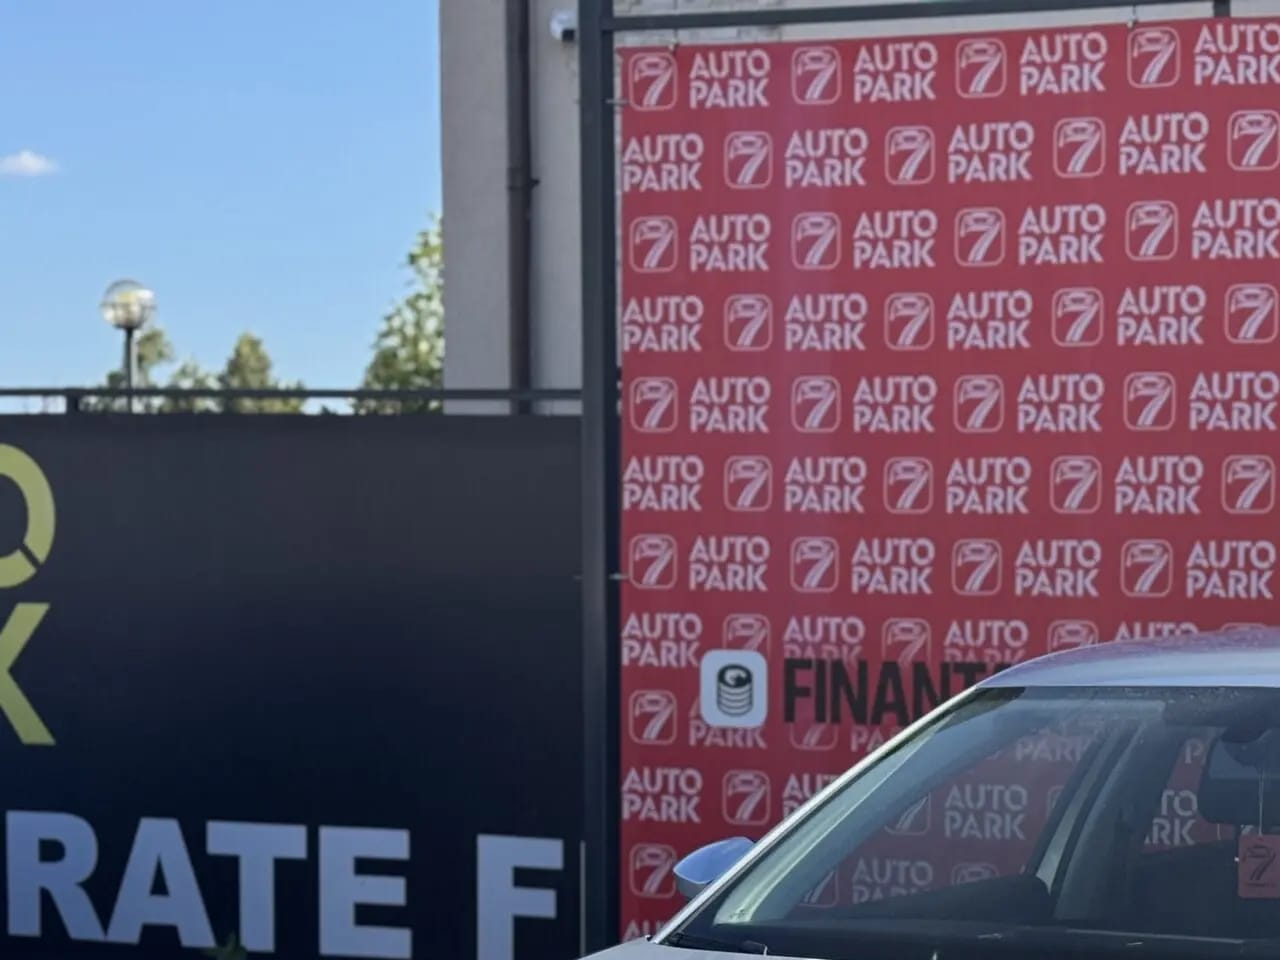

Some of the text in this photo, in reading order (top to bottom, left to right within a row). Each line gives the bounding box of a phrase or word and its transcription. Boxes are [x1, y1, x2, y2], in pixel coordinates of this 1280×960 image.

[855, 43, 937, 72] AUTO
[1021, 32, 1107, 64] AUTO
[690, 50, 770, 78] AUTO
[1020, 62, 1105, 95] PARK
[690, 78, 768, 108] PARK
[854, 71, 936, 102] PARK
[948, 121, 1034, 154] AUTO
[1119, 112, 1209, 145] AUTO
[623, 133, 704, 164] AUTO
[784, 128, 868, 159] AUTO
[785, 156, 866, 187] PARK
[948, 151, 1032, 183] PARK
[1120, 142, 1206, 175] PARK
[623, 162, 701, 192] PARK
[690, 214, 771, 243] AUTO
[853, 209, 938, 239] AUTO
[1018, 204, 1106, 236] AUTO
[690, 242, 768, 271] PARK
[853, 238, 936, 269] PARK
[1019, 233, 1103, 264] PARK
[1192, 228, 1280, 259] PARK
[623, 296, 704, 323] AUTO
[784, 294, 867, 322] AUTO
[947, 290, 1033, 321] AUTO
[1117, 285, 1207, 317] AUTO
[623, 322, 702, 352] PARK
[785, 321, 865, 350] PARK
[947, 318, 1031, 350] PARK
[1117, 314, 1205, 347] PARK
[690, 377, 771, 405] AUTO
[853, 376, 938, 405] AUTO
[1017, 373, 1104, 403] AUTO
[1189, 371, 1280, 400] AUTO
[690, 404, 768, 432] PARK
[853, 404, 936, 433] PARK
[1018, 402, 1101, 432] PARK
[1190, 400, 1277, 430] PARK
[623, 456, 705, 484] AUTO
[784, 457, 867, 485] AUTO
[946, 457, 1031, 486] AUTO
[1115, 455, 1203, 485] AUTO
[623, 482, 703, 511] PARK
[785, 484, 864, 512] PARK
[946, 485, 1028, 513] PARK
[1115, 484, 1200, 514] PARK
[689, 536, 771, 565] AUTO
[852, 538, 935, 566] AUTO
[1015, 539, 1101, 568] AUTO
[1186, 540, 1276, 570] AUTO
[689, 563, 769, 592] PARK
[852, 565, 932, 594] PARK
[1015, 567, 1098, 596] PARK
[1187, 569, 1273, 598] PARK
[622, 613, 702, 640] AUTO
[783, 616, 865, 644] AUTO
[944, 620, 1028, 647] AUTO
[622, 640, 699, 667] PARK
[783, 658, 1011, 725] FINANT
[622, 767, 702, 795] AUTO
[622, 794, 700, 822] PARK
[945, 785, 1027, 811] AUTO
[944, 811, 1025, 840] PARK
[6, 811, 412, 959] RATE
[852, 858, 933, 886] AUTO
